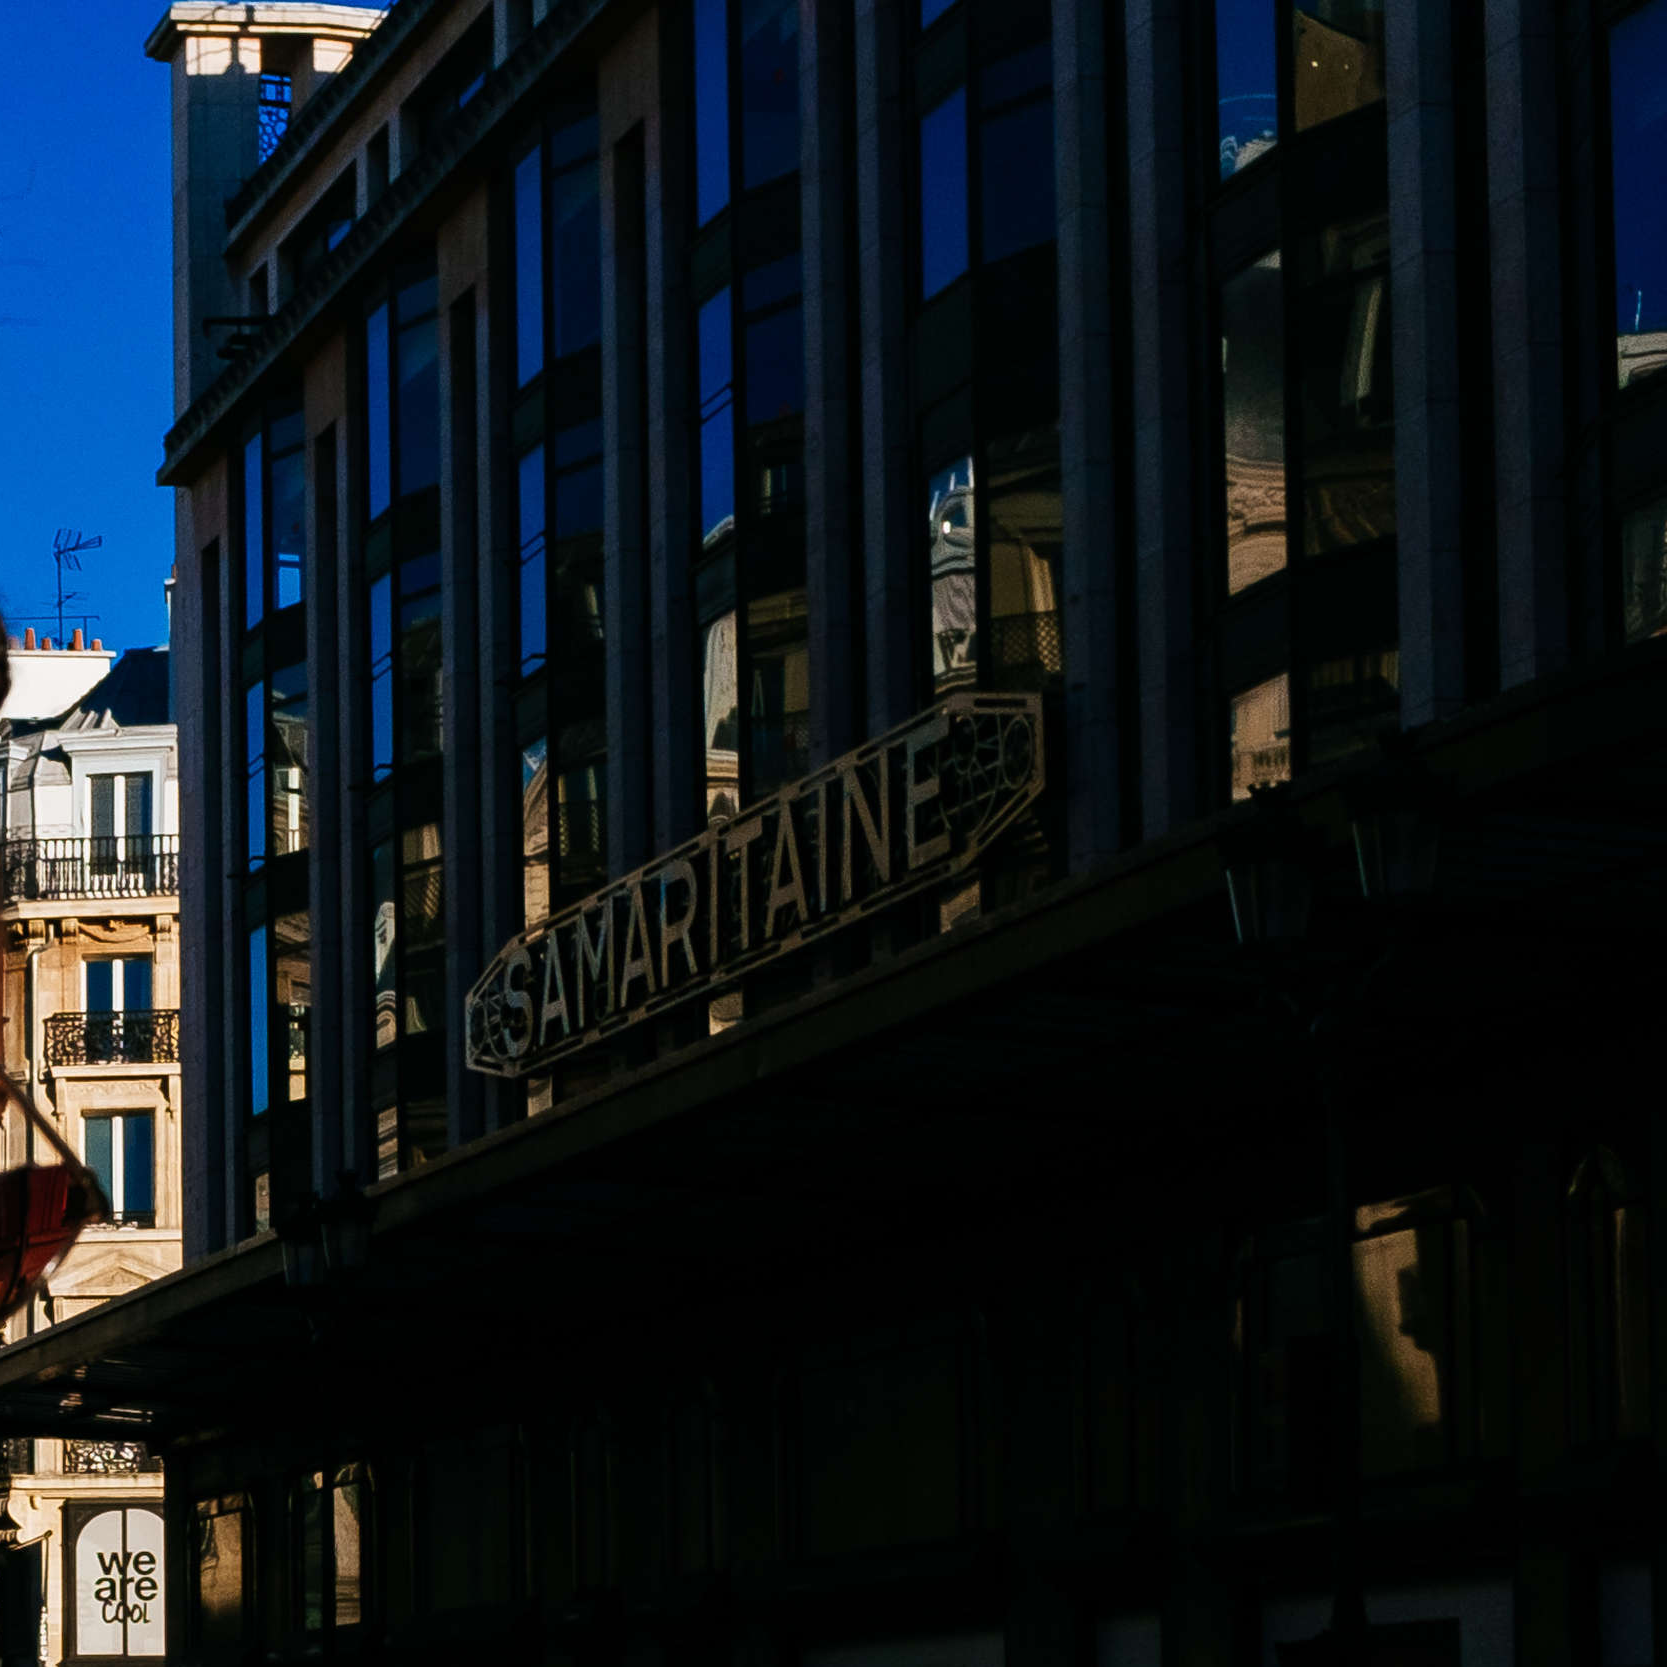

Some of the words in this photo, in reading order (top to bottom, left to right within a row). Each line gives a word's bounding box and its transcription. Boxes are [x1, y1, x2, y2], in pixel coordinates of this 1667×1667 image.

[503, 706, 951, 1059] SAMARITAINE
[96, 1551, 157, 1576] we
[94, 1576, 159, 1602] are
